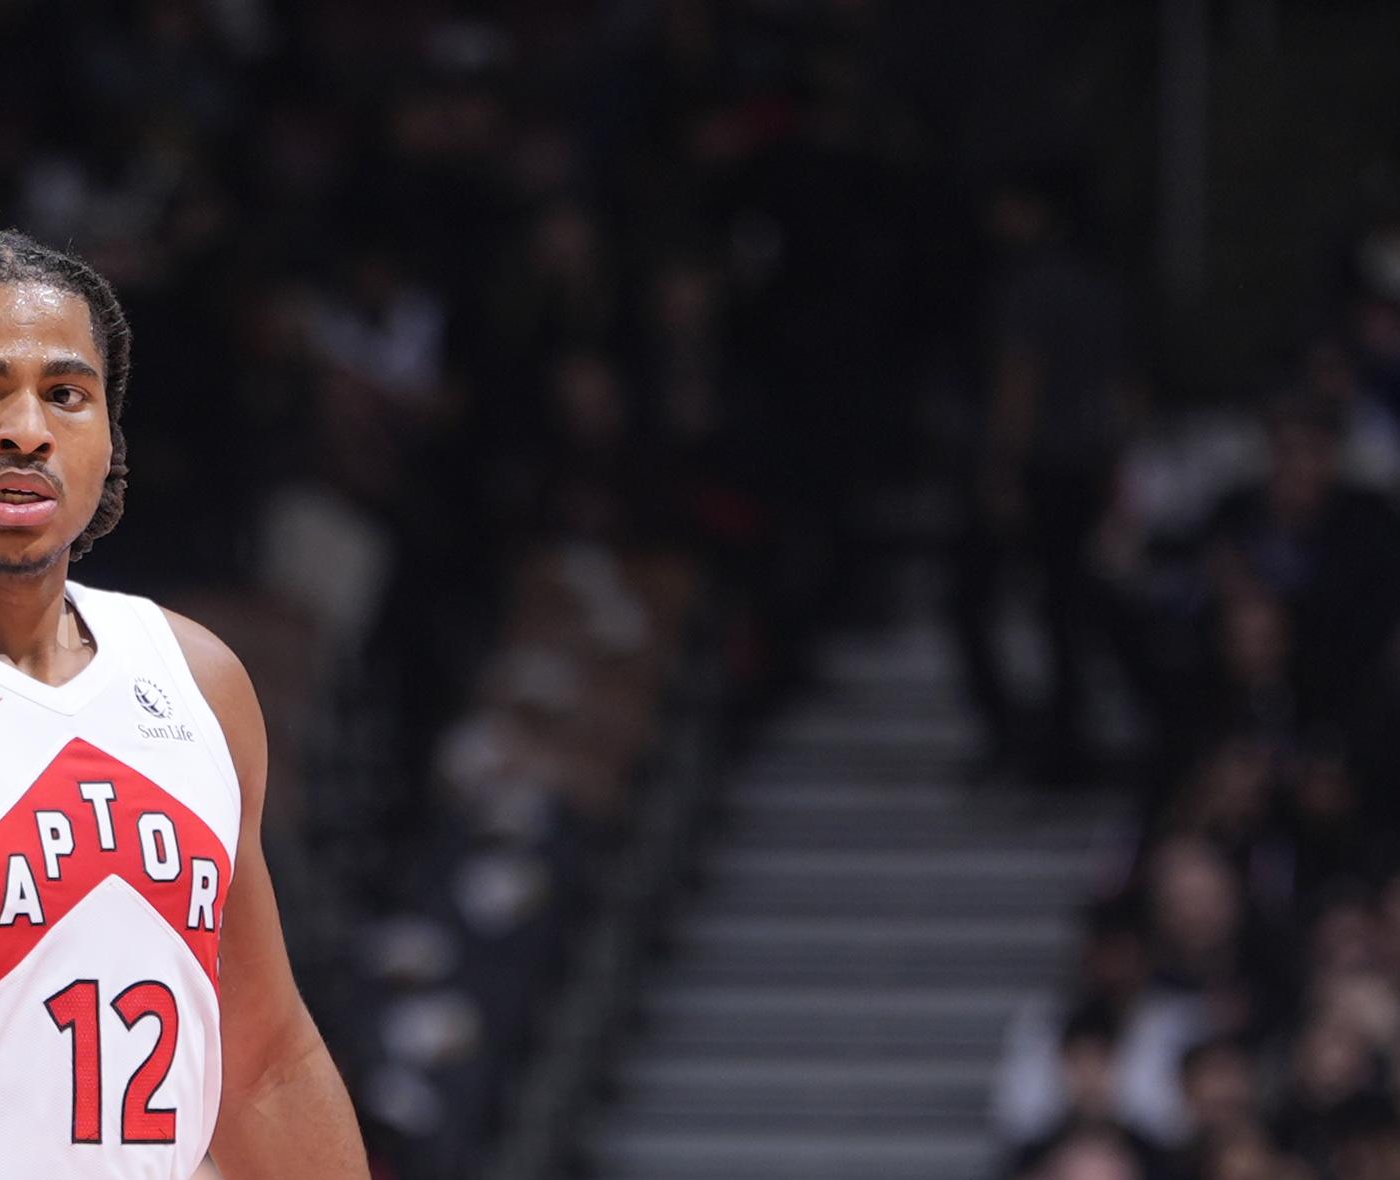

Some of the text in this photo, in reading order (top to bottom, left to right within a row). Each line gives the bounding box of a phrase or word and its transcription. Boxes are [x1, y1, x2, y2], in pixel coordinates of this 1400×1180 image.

[137, 723, 194, 743] Sun Life
[43, 979, 180, 1145] 12
